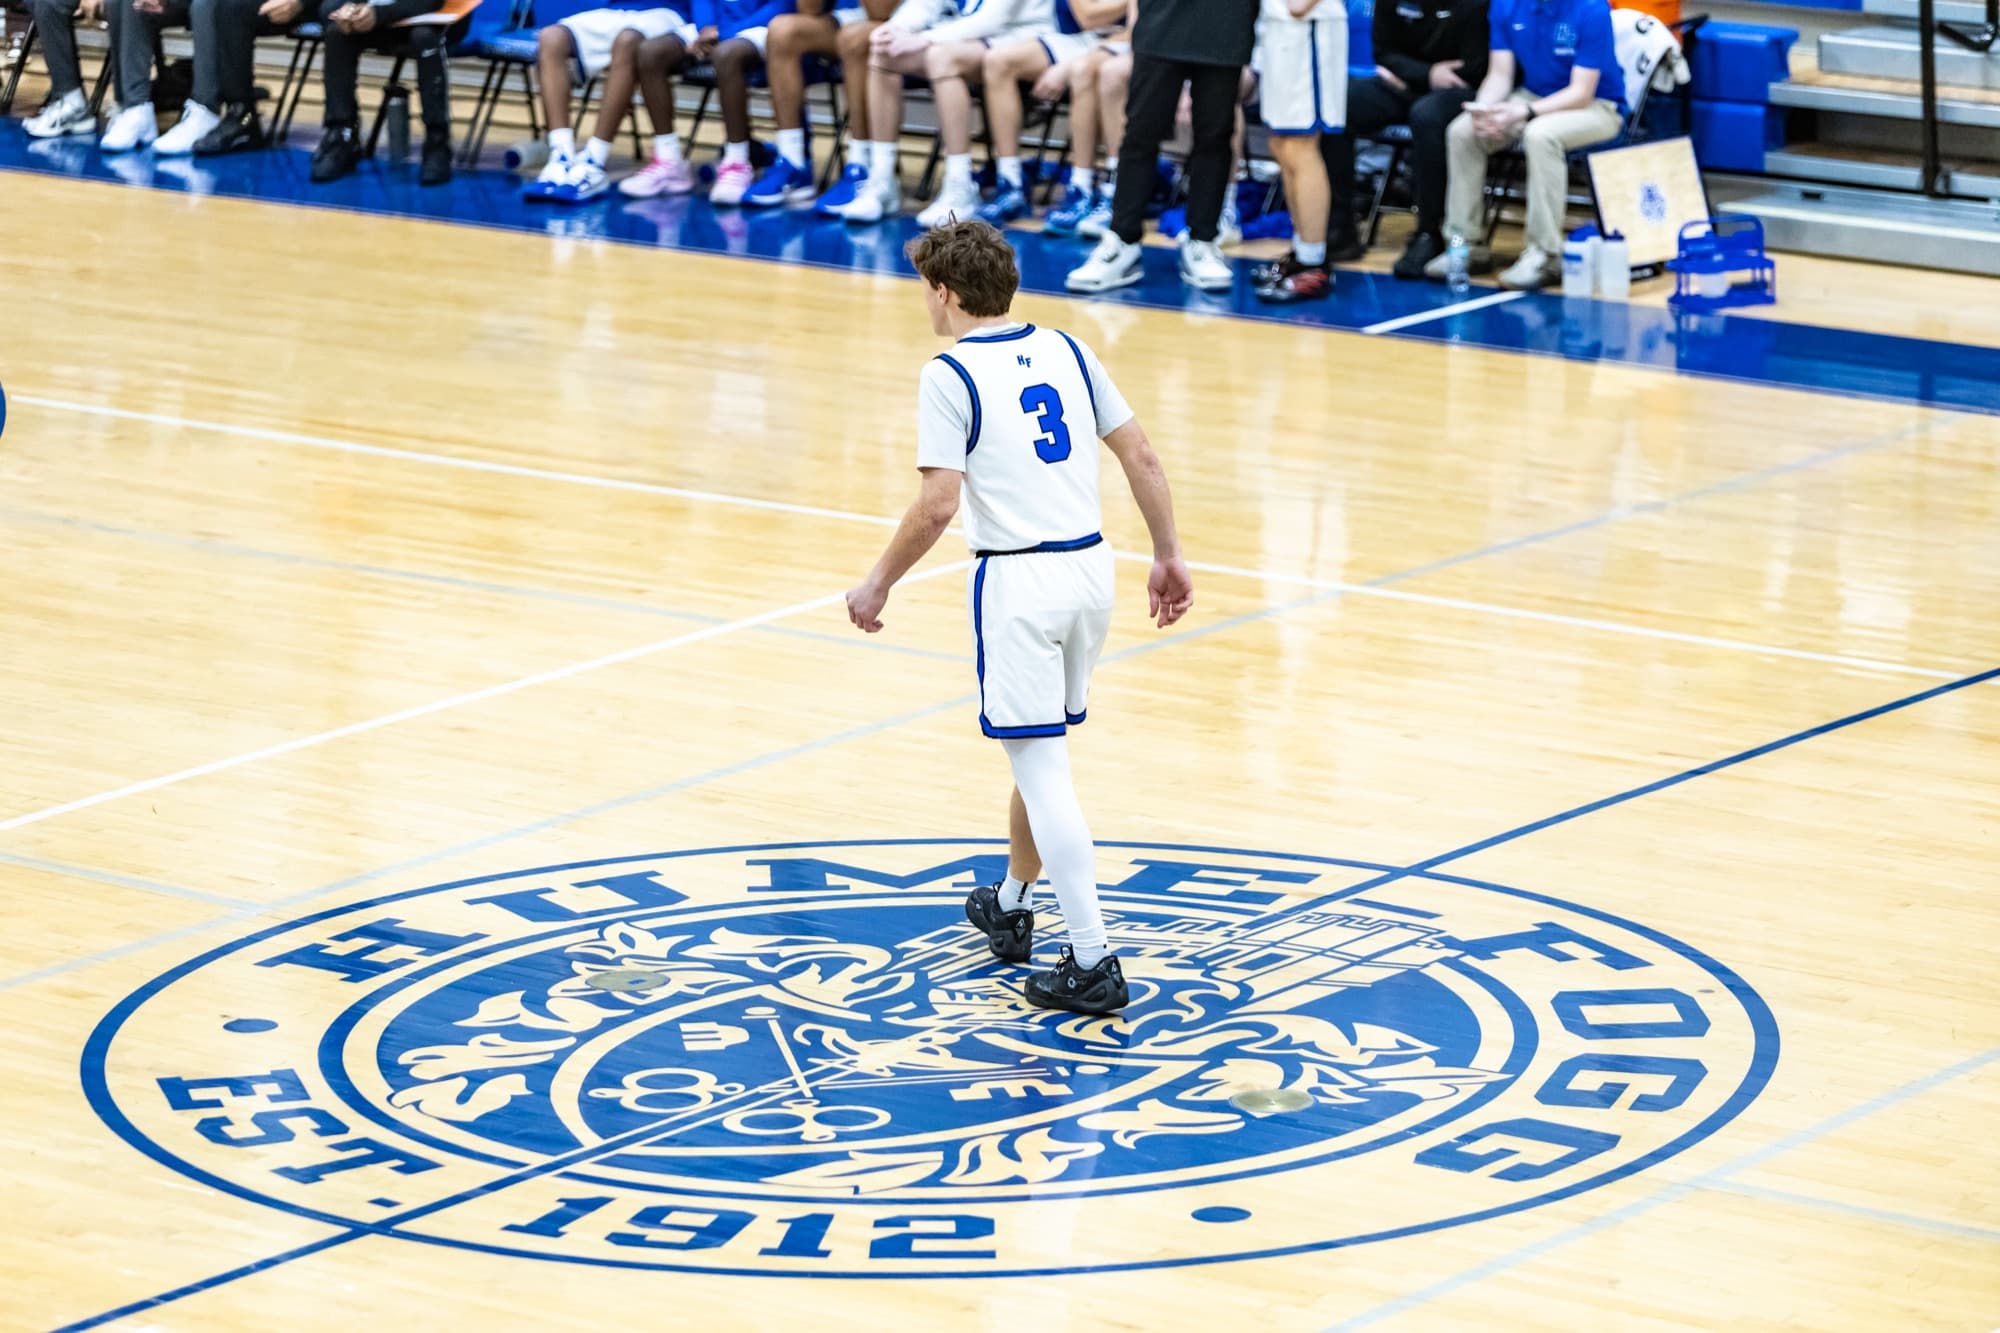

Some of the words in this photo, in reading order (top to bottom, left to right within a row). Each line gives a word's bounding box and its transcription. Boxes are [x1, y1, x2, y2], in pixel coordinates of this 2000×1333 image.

[1019, 382, 1072, 464] 3
[156, 1068, 444, 1208] EST.
[499, 1195, 997, 1260] 1912
